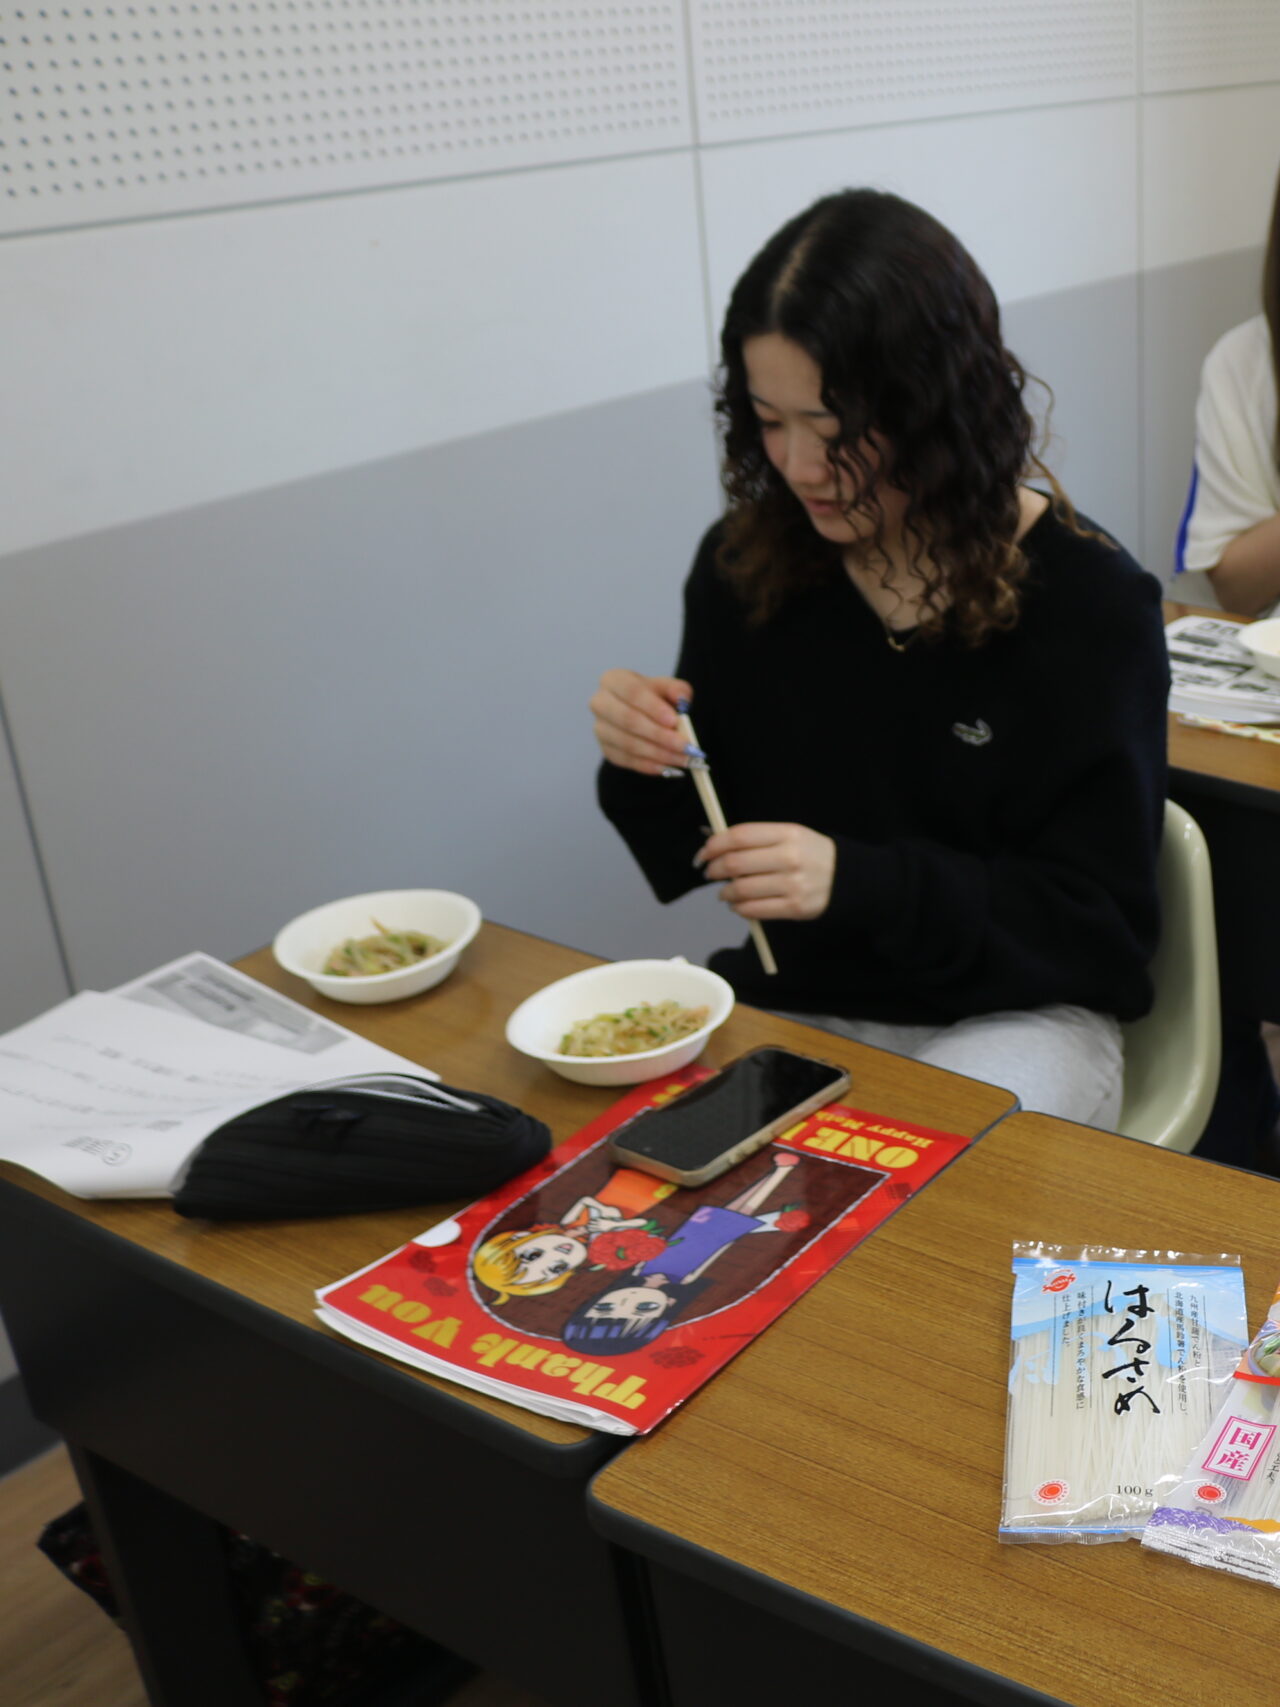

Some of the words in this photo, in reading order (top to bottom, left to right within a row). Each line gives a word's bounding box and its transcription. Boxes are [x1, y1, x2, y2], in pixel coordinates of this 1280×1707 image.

[802, 1127, 919, 1169] ONE
[866, 1121, 934, 1149] Happy
[358, 1284, 463, 1349] You
[471, 1333, 647, 1410] Thank
[1102, 1280, 1161, 1416] はるさめ
[1216, 1426, 1262, 1472] 国産
